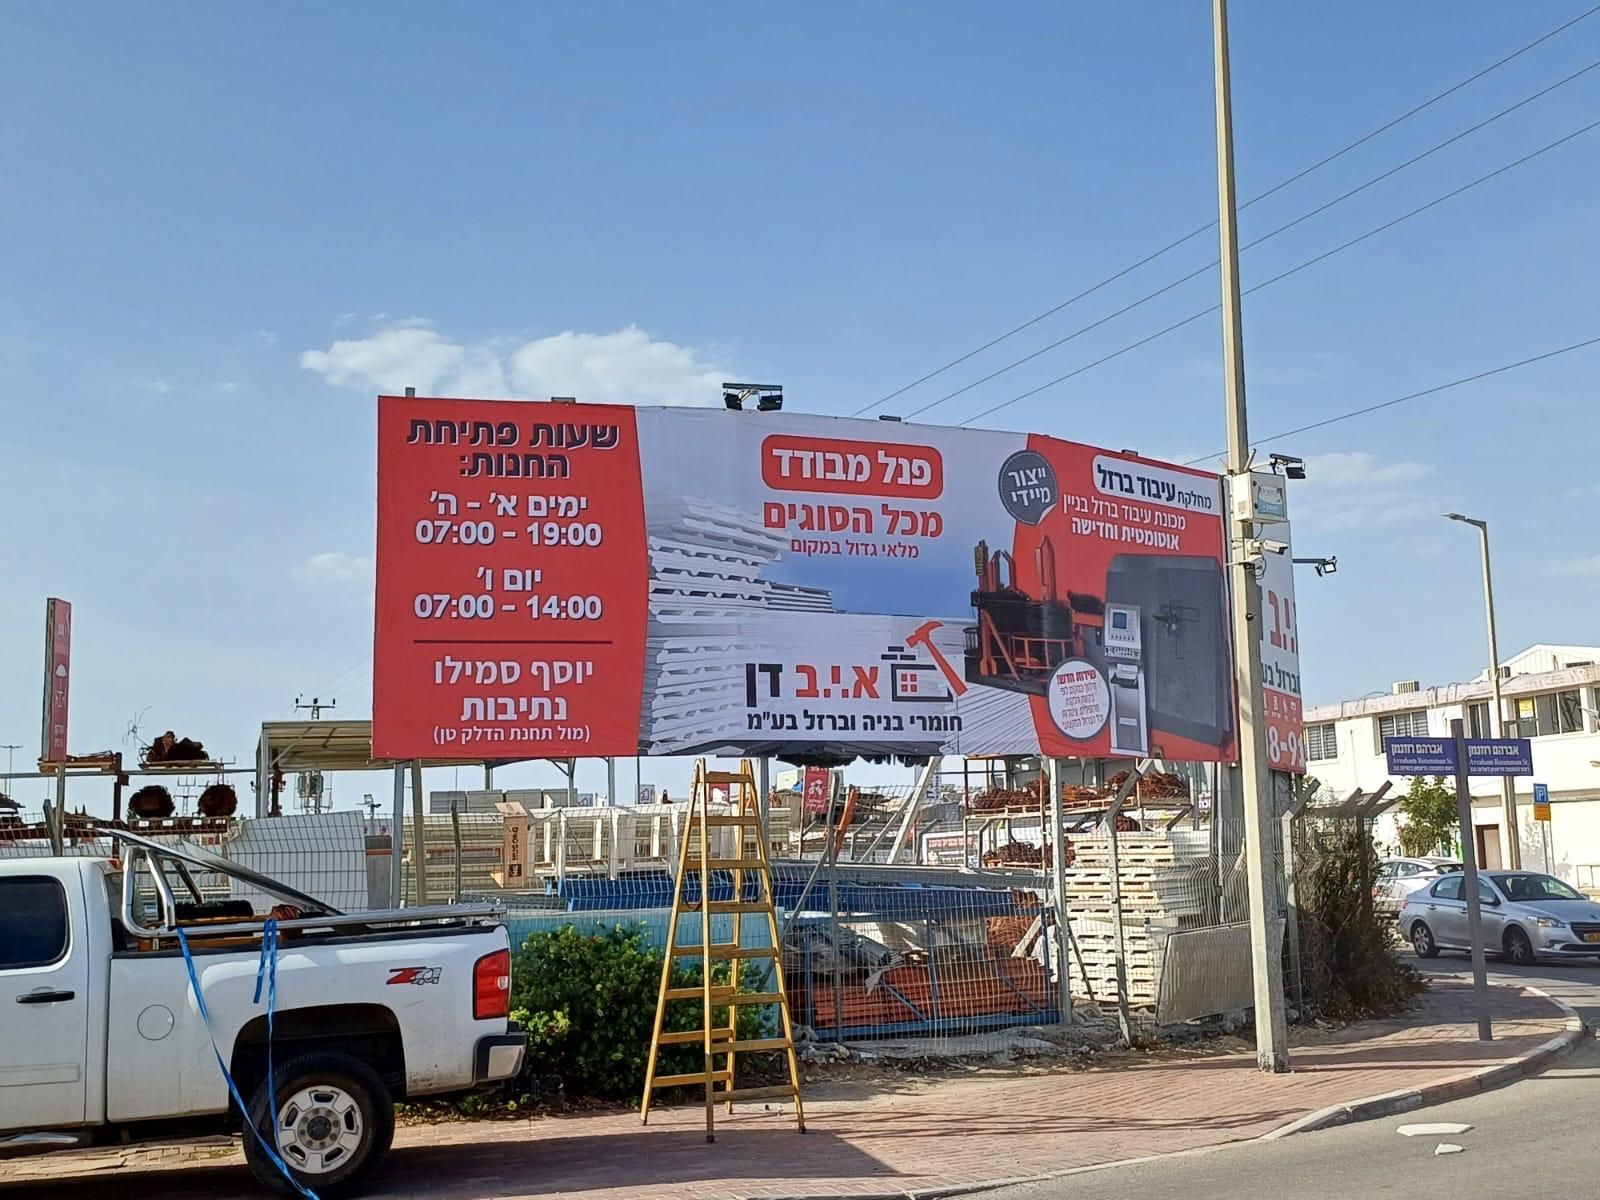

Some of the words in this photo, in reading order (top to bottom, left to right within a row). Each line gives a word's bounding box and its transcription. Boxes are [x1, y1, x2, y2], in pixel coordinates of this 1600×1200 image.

[407, 419, 520, 447] פתיחת
[530, 422, 620, 450] שעות
[460, 452, 570, 479] החנות:
[772, 448, 871, 482] מבודד
[877, 450, 932, 486] פנל
[1008, 467, 1046, 487] ייצור
[1098, 464, 1135, 494] ברזל
[1011, 487, 1050, 506] מיידי
[1137, 476, 1176, 502] עיבוד
[1178, 490, 1212, 510] מחלקת
[527, 495, 588, 517] ימים
[1091, 496, 1119, 519] ברזל
[1122, 504, 1151, 524] עיבוד
[764, 502, 873, 534] הסוגים
[881, 504, 943, 538] מכל
[1072, 517, 1118, 540] וחדישה
[1154, 512, 1186, 530] מכונת
[415, 520, 495, 544] 07:00
[527, 522, 602, 546] 19:00
[1121, 527, 1180, 550] אוטומטית
[791, 538, 842, 557] במקום
[845, 539, 878, 557] גדול
[881, 542, 919, 559] מלאי
[503, 568, 542, 591] יום
[414, 594, 494, 619] 07:00
[526, 595, 602, 620] 14:00
[434, 655, 520, 685] סמילו
[530, 660, 593, 691] יוסף
[745, 663, 783, 708] דן
[460, 697, 567, 721] נתיבות
[803, 709, 856, 731] וברזל
[461, 725, 504, 744] הדלק
[509, 726, 552, 741] תחנת
[862, 715, 904, 731] בניה
[909, 715, 963, 731] חומרי
[1416, 744, 1443, 754] אברהם
[1492, 746, 1520, 756] אברהם
